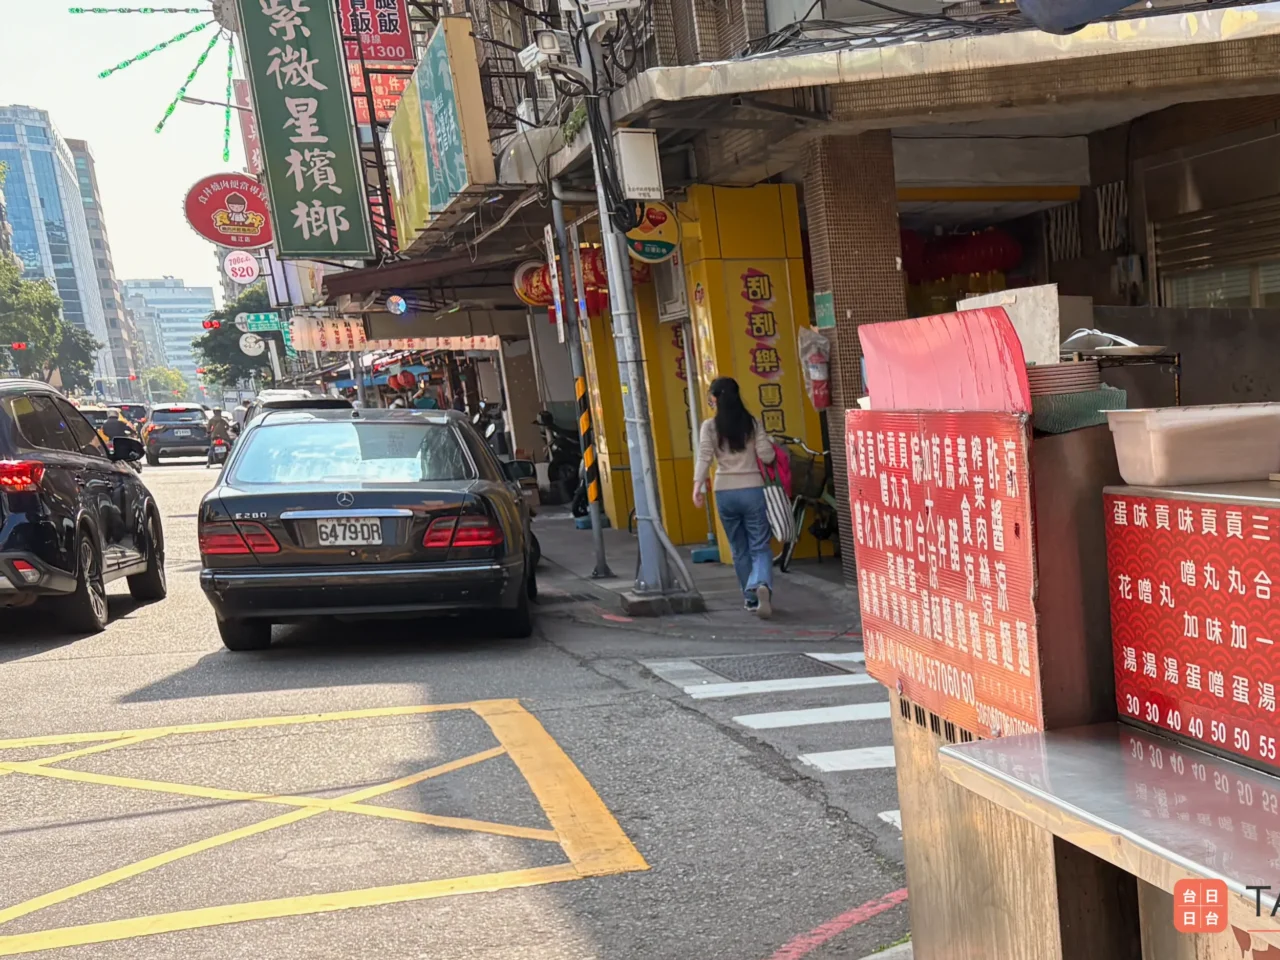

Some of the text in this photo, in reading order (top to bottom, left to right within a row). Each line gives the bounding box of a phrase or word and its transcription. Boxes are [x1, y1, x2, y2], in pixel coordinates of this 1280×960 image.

[261, 0, 350, 246] 紫微星檳榔
[230, 266, 254, 279] $20
[1113, 501, 1137, 673] 蛋花湯
[1133, 503, 1157, 679] 味噌湯
[1154, 504, 1179, 685] 貢丸湯
[1177, 506, 1202, 692] 味噌加蛋
[1201, 508, 1225, 698] 貢丸味噌
[1225, 510, 1250, 706] 貢丸加蛋
[1251, 515, 1277, 712] 三合一湯
[961, 670, 975, 707] 60
[1126, 694, 1276, 760] 30 30 40 40 50 50 55
